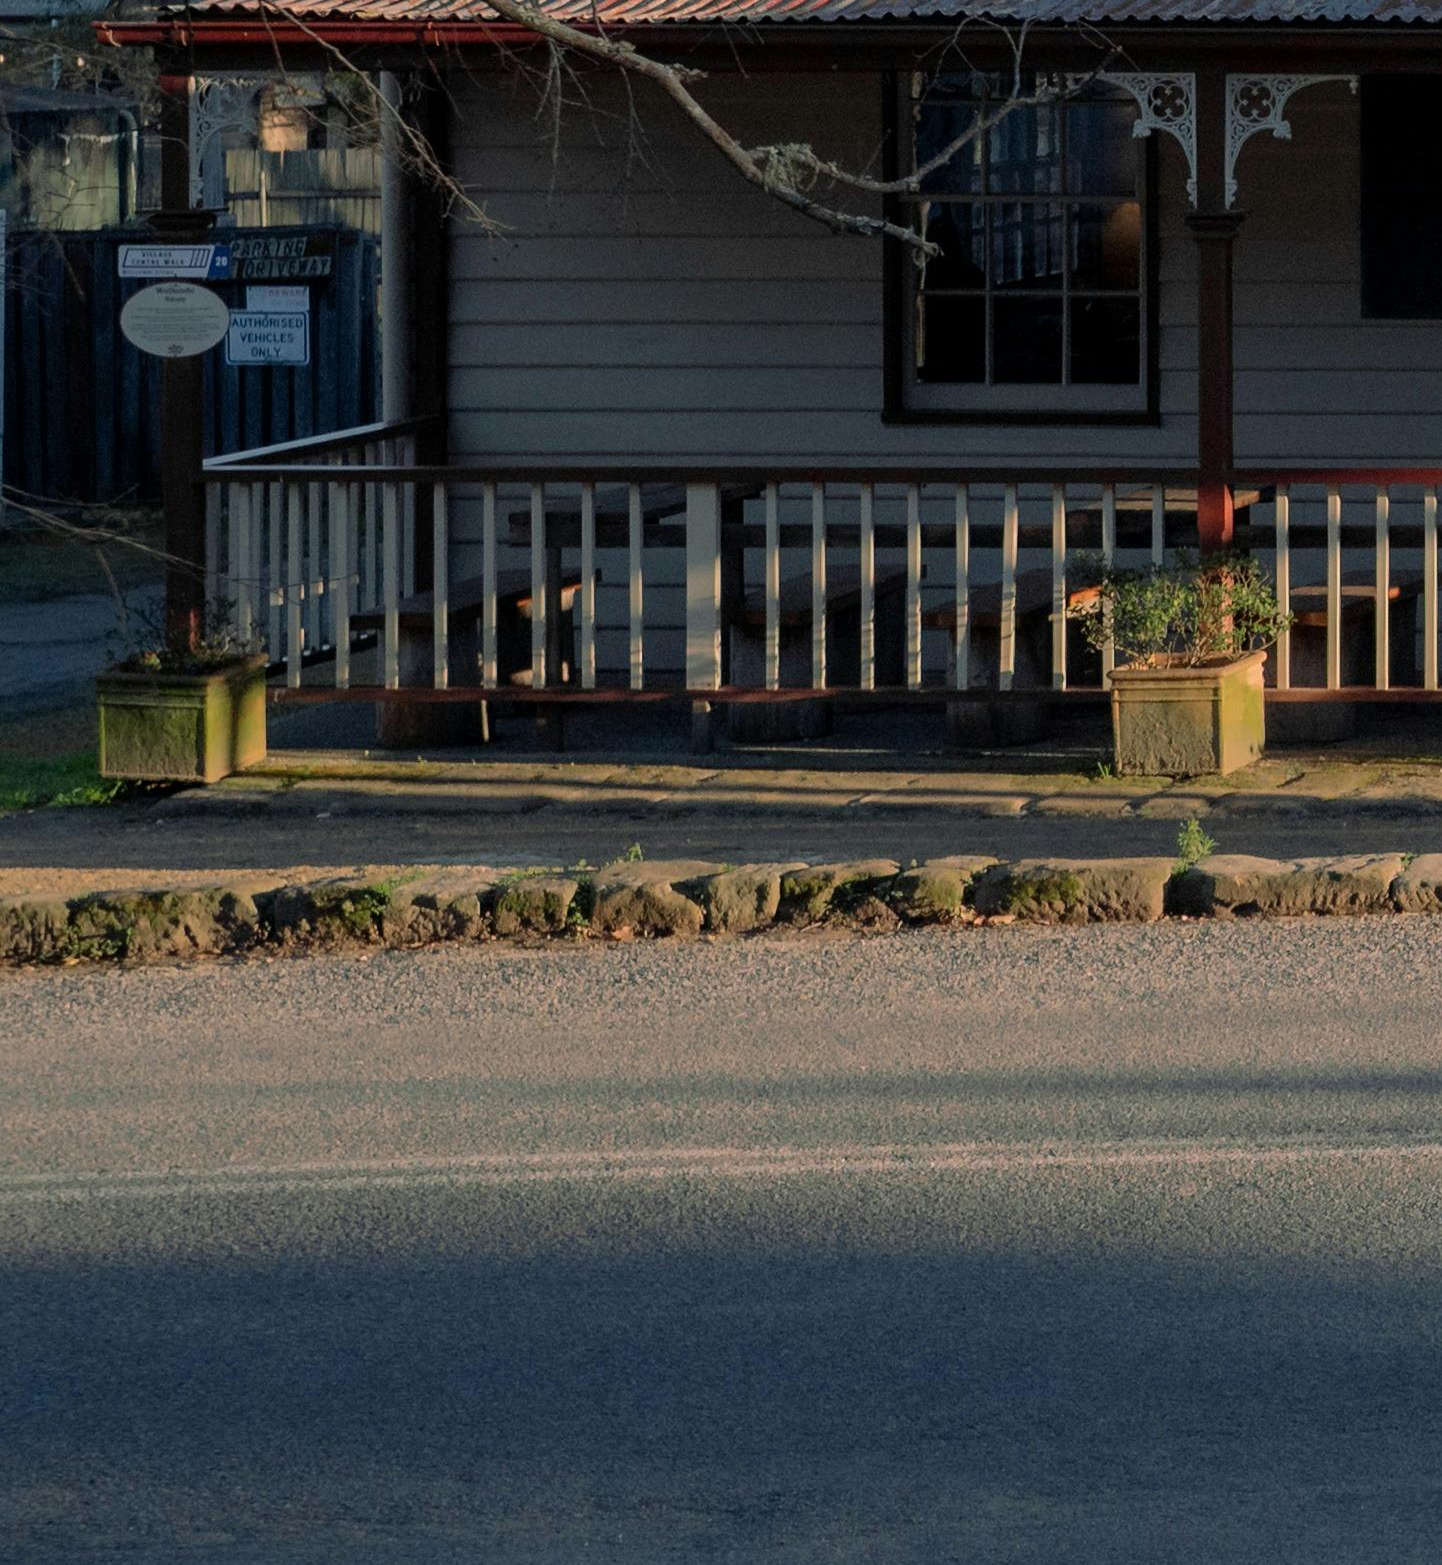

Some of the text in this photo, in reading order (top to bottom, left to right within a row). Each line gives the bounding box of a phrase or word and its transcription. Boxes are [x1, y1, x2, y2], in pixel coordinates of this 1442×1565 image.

[231, 238, 305, 256] PARKING
[215, 256, 228, 267] 20
[245, 257, 330, 277] DRIVEWAY
[231, 317, 304, 328] AUTHORISED
[239, 333, 295, 343] VEHICLES
[251, 347, 281, 357] ONLY
